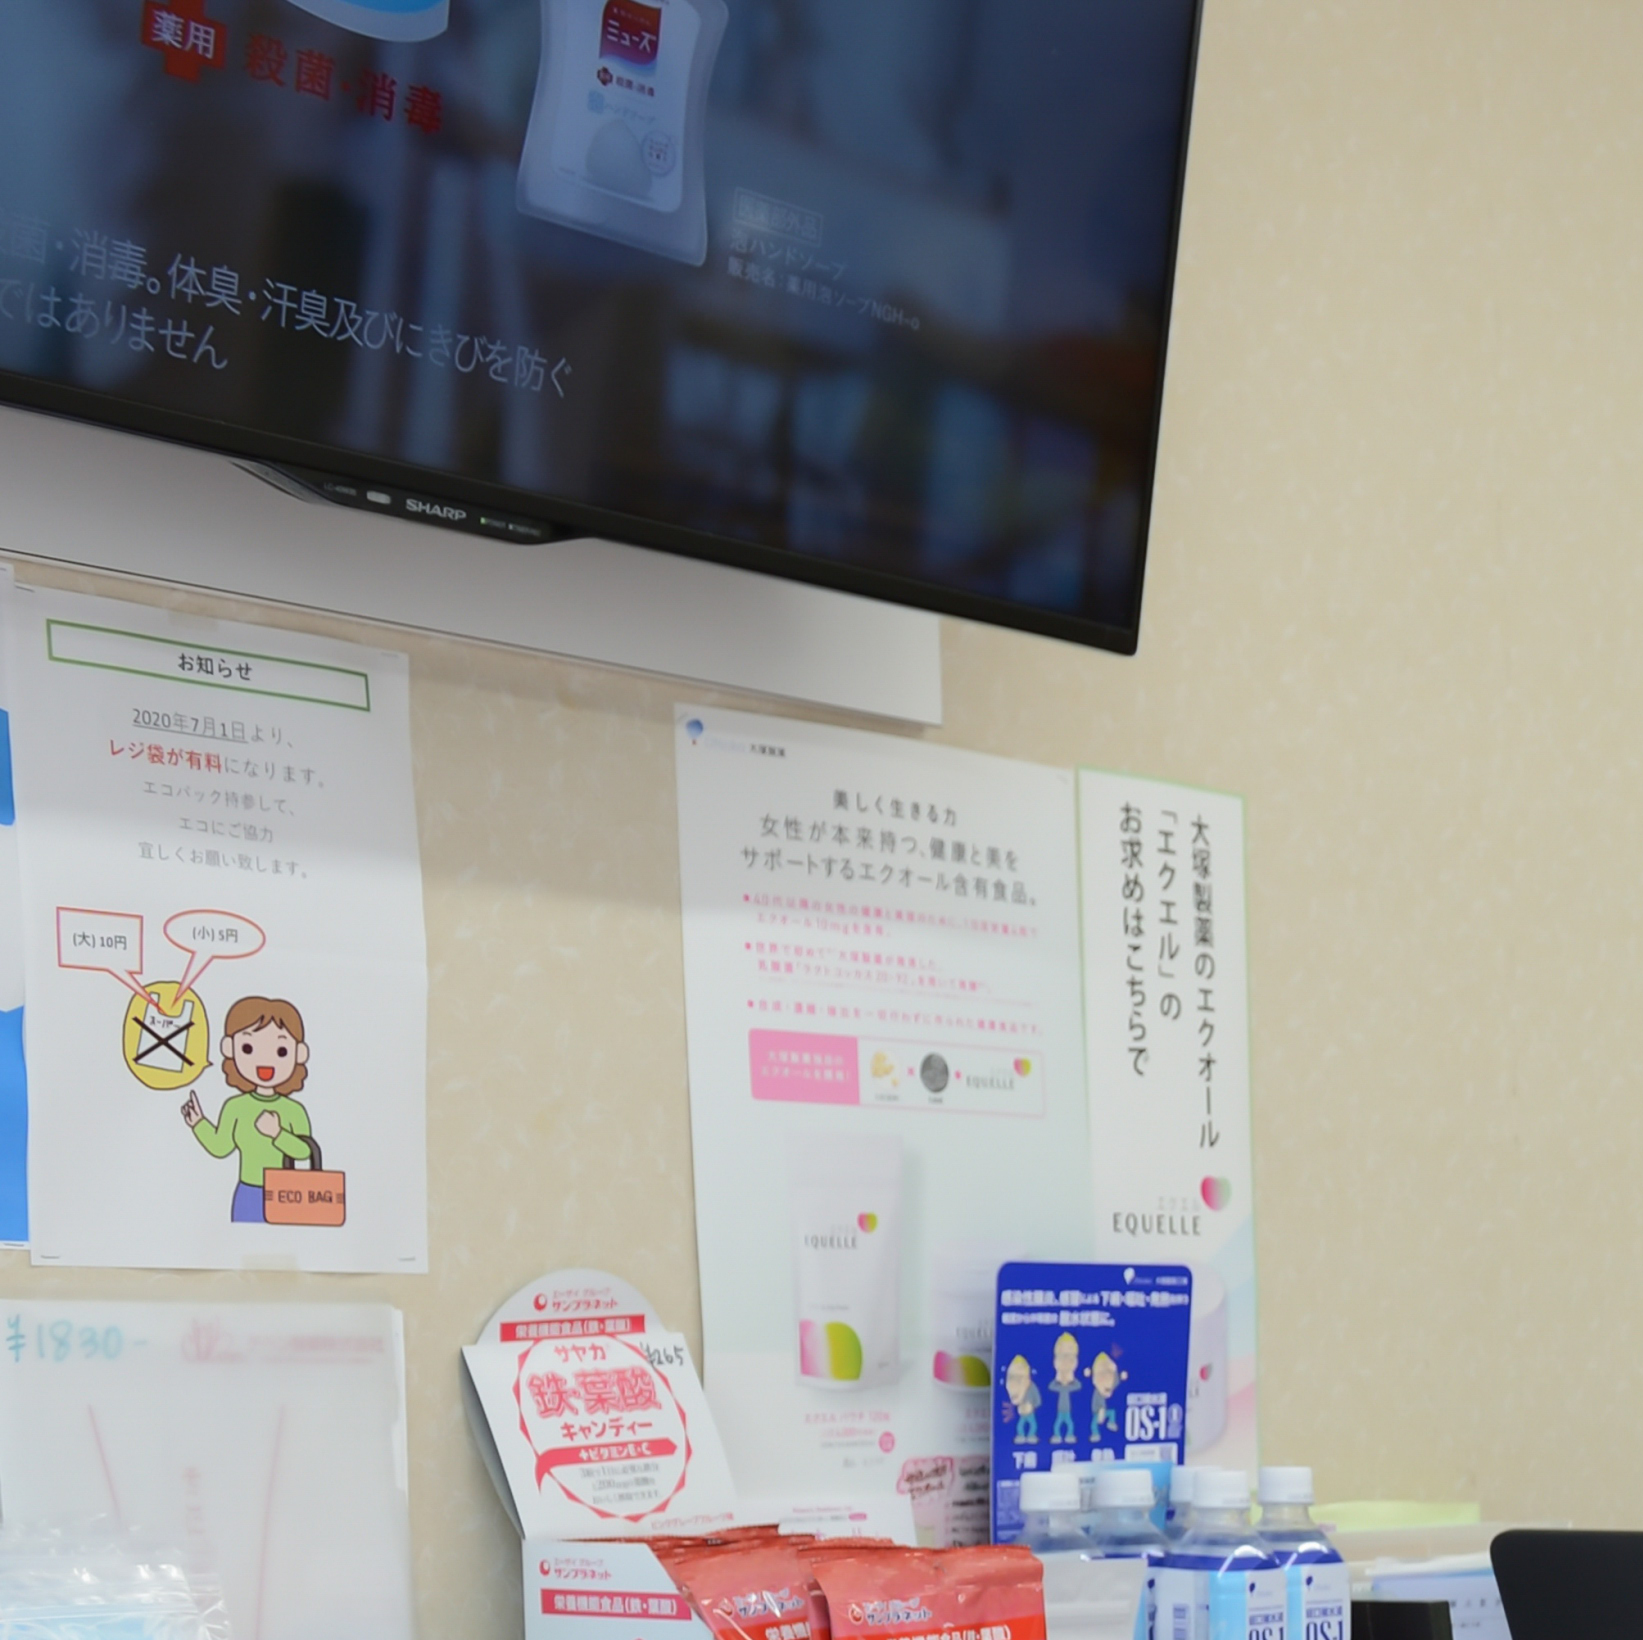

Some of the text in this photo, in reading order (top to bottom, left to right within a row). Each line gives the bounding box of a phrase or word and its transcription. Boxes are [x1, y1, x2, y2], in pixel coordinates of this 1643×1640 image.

[151, 13, 217, 60] 薬用
[0, 211, 574, 398] 菌・消毒。体臭・汗臭及びにきびを防ぐ
[404, 497, 468, 522] SHARP
[177, 652, 253, 681] お知らせ
[109, 739, 325, 789] レジ袋が有料になります。
[833, 788, 958, 827] 美しく生きる力
[1118, 801, 1150, 1078] お求めはこちらで
[1190, 813, 1220, 1150] 大塚製薬のエクオール
[277, 1188, 335, 1206] ECO BAG
[1111, 1211, 1203, 1238] EQUELLE
[554, 1342, 607, 1363] サヤカ
[560, 1416, 654, 1442] キャンディー
[1124, 1405, 1168, 1441] OS-1
